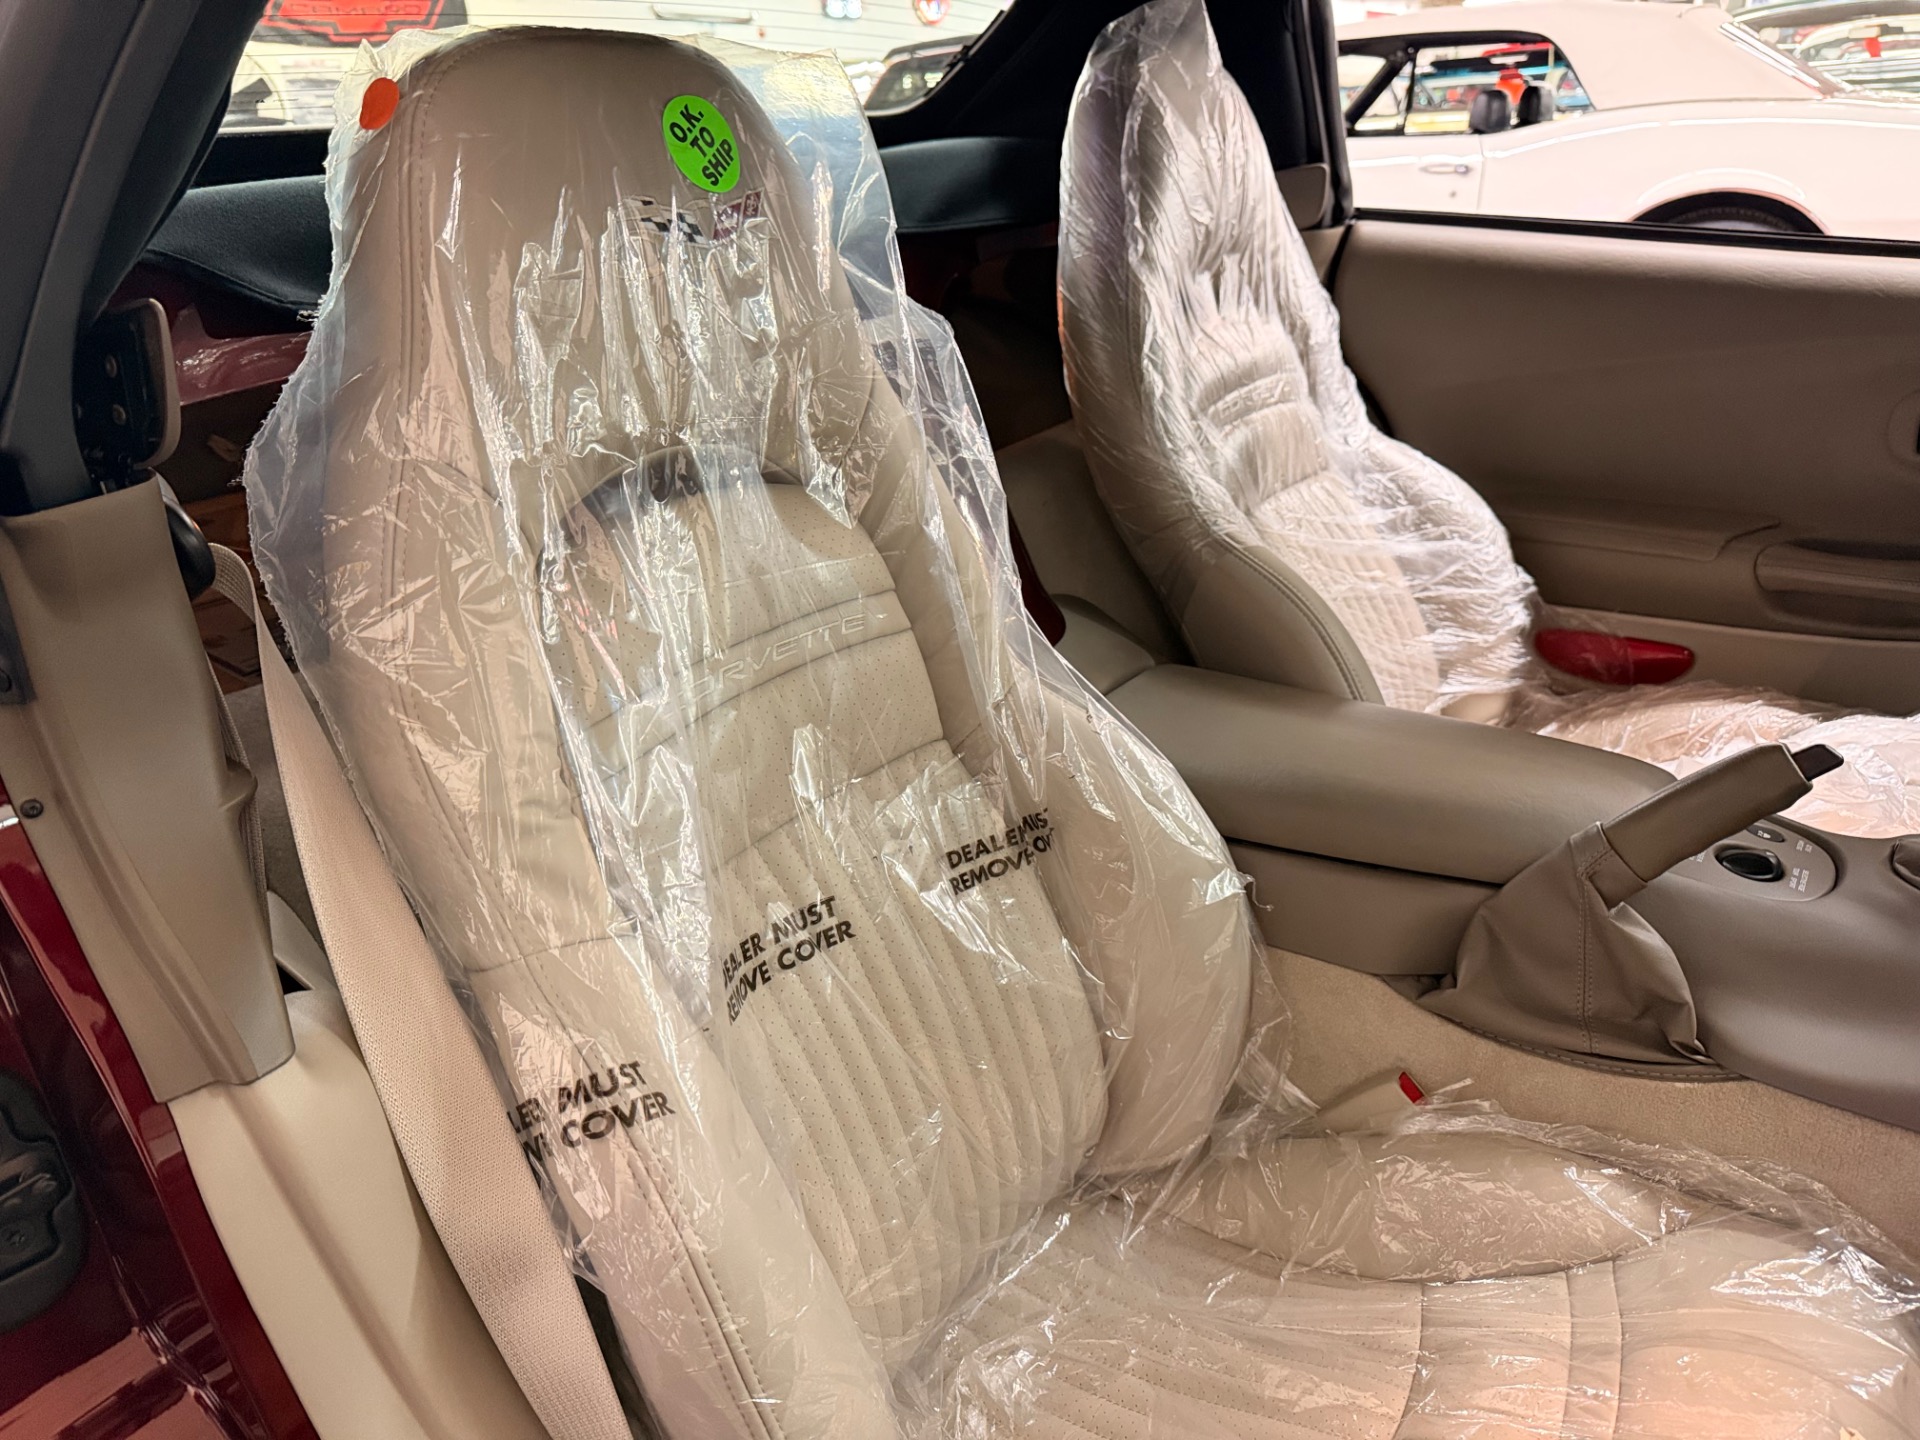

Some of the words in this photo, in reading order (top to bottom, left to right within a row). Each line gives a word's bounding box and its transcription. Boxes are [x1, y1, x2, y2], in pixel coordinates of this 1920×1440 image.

[669, 103, 704, 143] O.K.
[689, 126, 716, 158] TO
[701, 138, 734, 187] SHIP
[657, 613, 867, 720] ORVETTE
[771, 895, 836, 945] MUST
[777, 920, 857, 970] COVER
[561, 1091, 676, 1148] COVER
